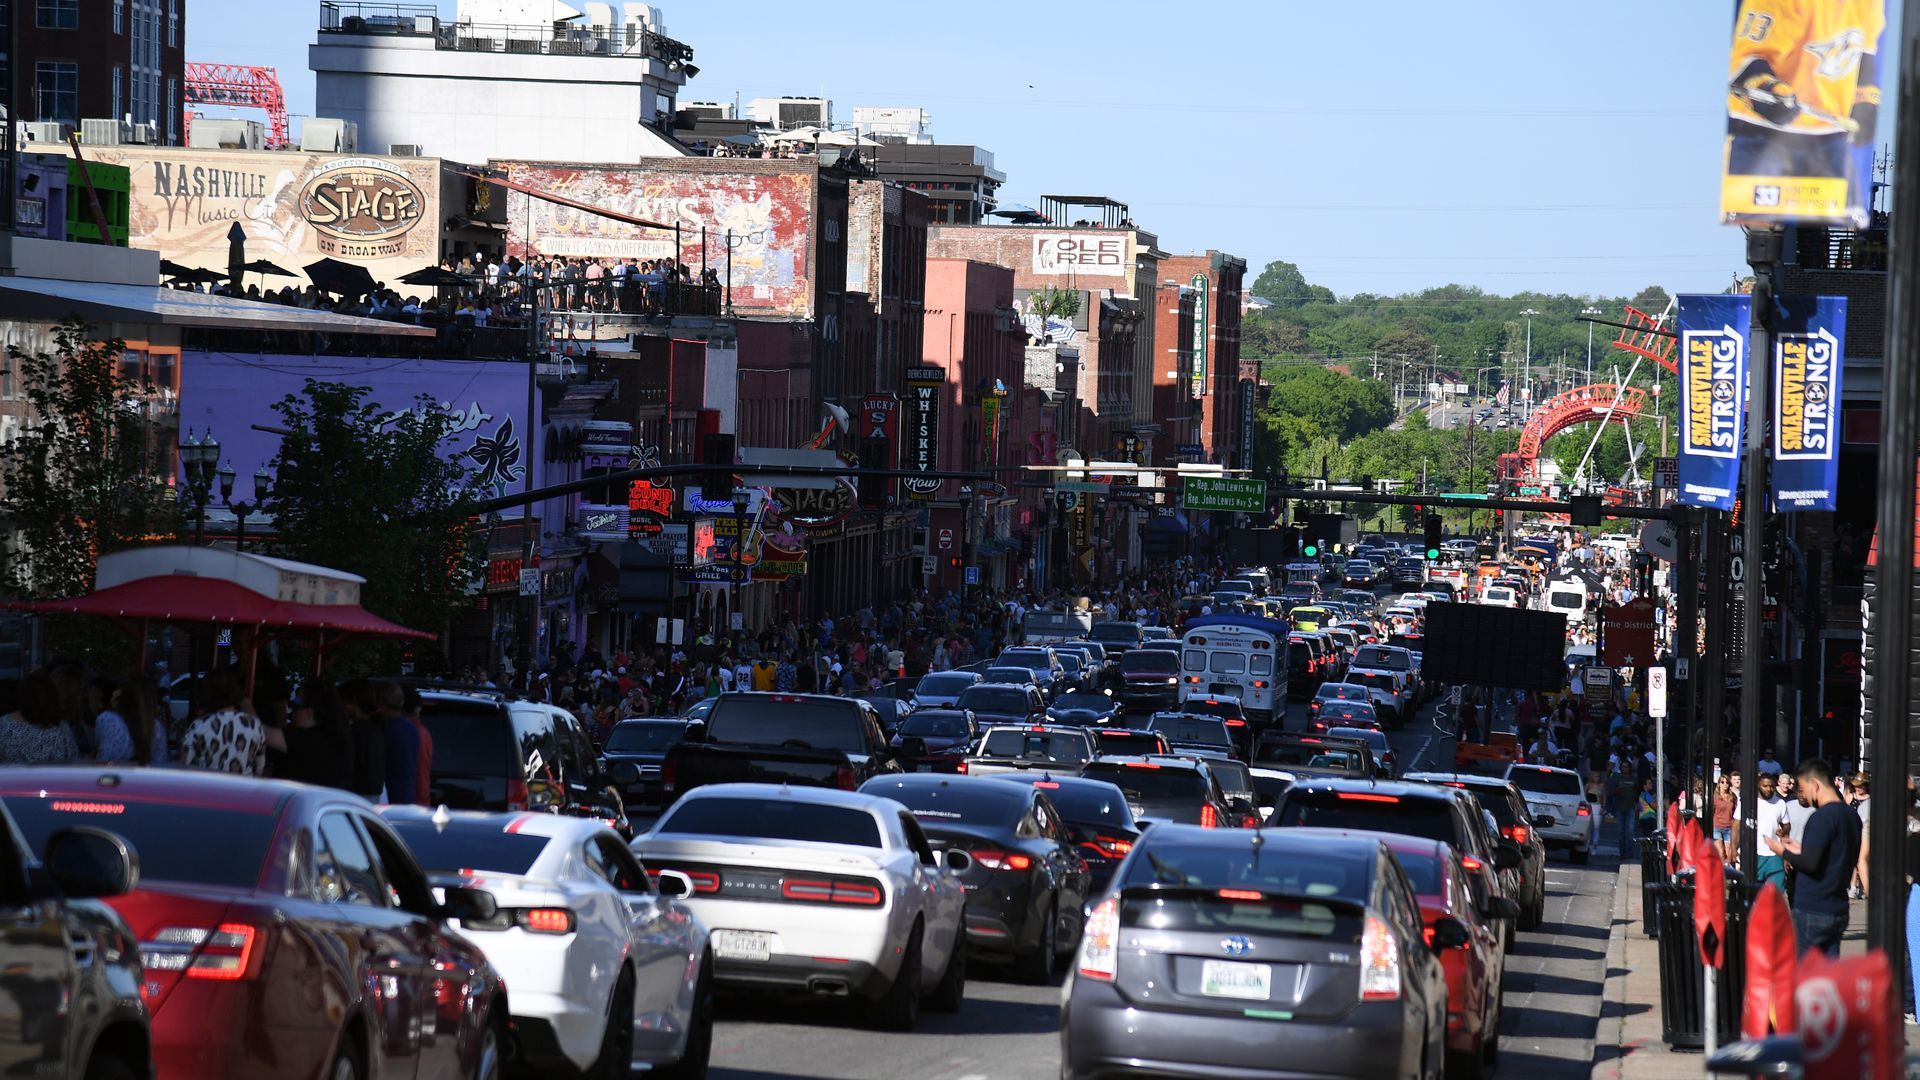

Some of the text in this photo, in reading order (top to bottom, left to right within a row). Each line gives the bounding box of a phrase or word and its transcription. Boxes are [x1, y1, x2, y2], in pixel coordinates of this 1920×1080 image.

[324, 158, 400, 172] ROOFTOP PATIO
[153, 161, 266, 199] NASHVILLE
[350, 172, 374, 187] THE
[309, 178, 418, 223] STAGE
[159, 193, 275, 233] Music City
[320, 240, 403, 257] ON BROADWAY
[546, 239, 571, 253] WHEN
[584, 240, 612, 254] MAKES
[621, 241, 668, 256] DIFFERENCE
[1057, 239, 1120, 253] OLE
[1057, 252, 1120, 265] RED
[1690, 340, 1713, 447] SMASHVILLE
[1781, 341, 1808, 450] SMASHVILLE
[863, 400, 896, 411] LUCKY
[588, 432, 604, 442] World
[917, 388, 932, 472] WHISKEY
[1125, 438, 1136, 484] WHISY
[1197, 479, 1262, 494] Rep. John Lewis Way N
[629, 488, 673, 503] COND
[1187, 493, 1252, 508] Rep. John Lewis Way S
[1778, 490, 1830, 500] BRIDGESTONE
[629, 498, 671, 517] DDLE
[695, 572, 721, 580] GRILL
[1607, 621, 1654, 630] The District
[738, 672, 749, 683] 32
